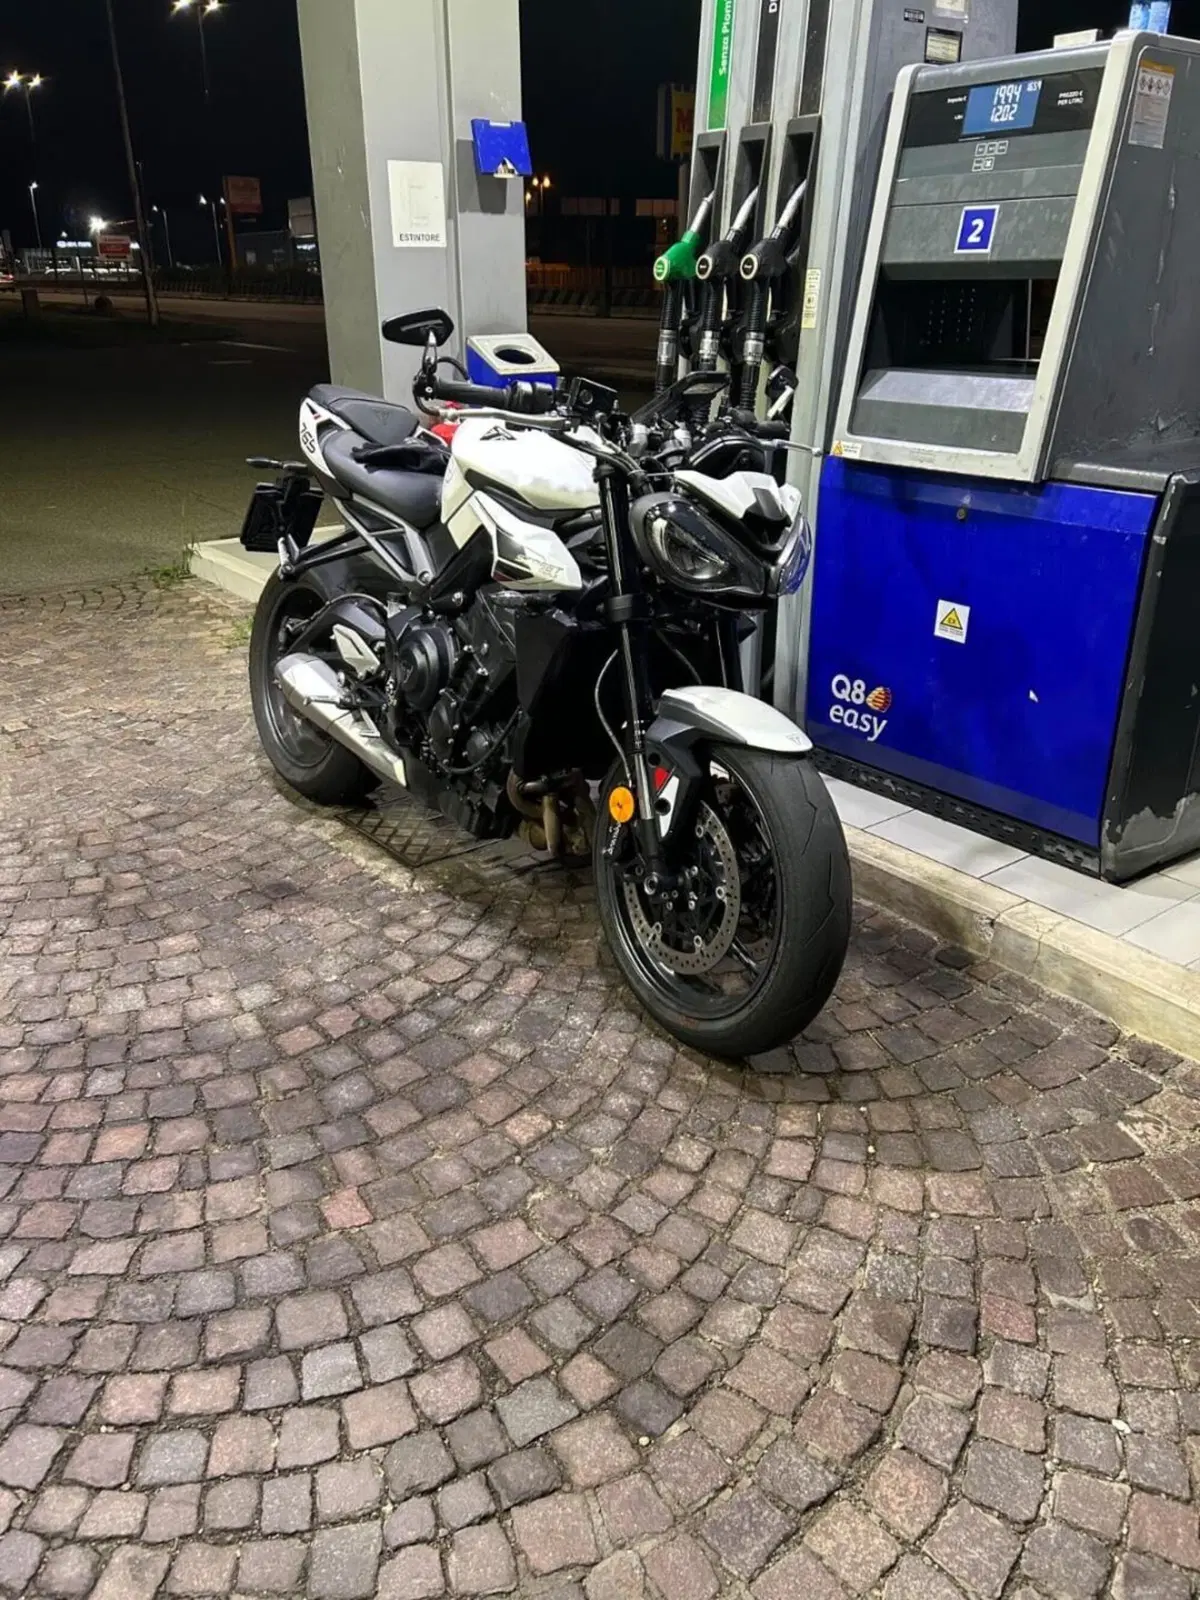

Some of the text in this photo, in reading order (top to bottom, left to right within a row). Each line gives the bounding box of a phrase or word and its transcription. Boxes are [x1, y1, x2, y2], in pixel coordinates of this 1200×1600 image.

[719, 0, 732, 76] Senza Plom
[399, 233, 440, 242] ESTINTORE
[967, 218, 984, 243] 2
[831, 674, 866, 704] Q8
[829, 704, 887, 742] easy
